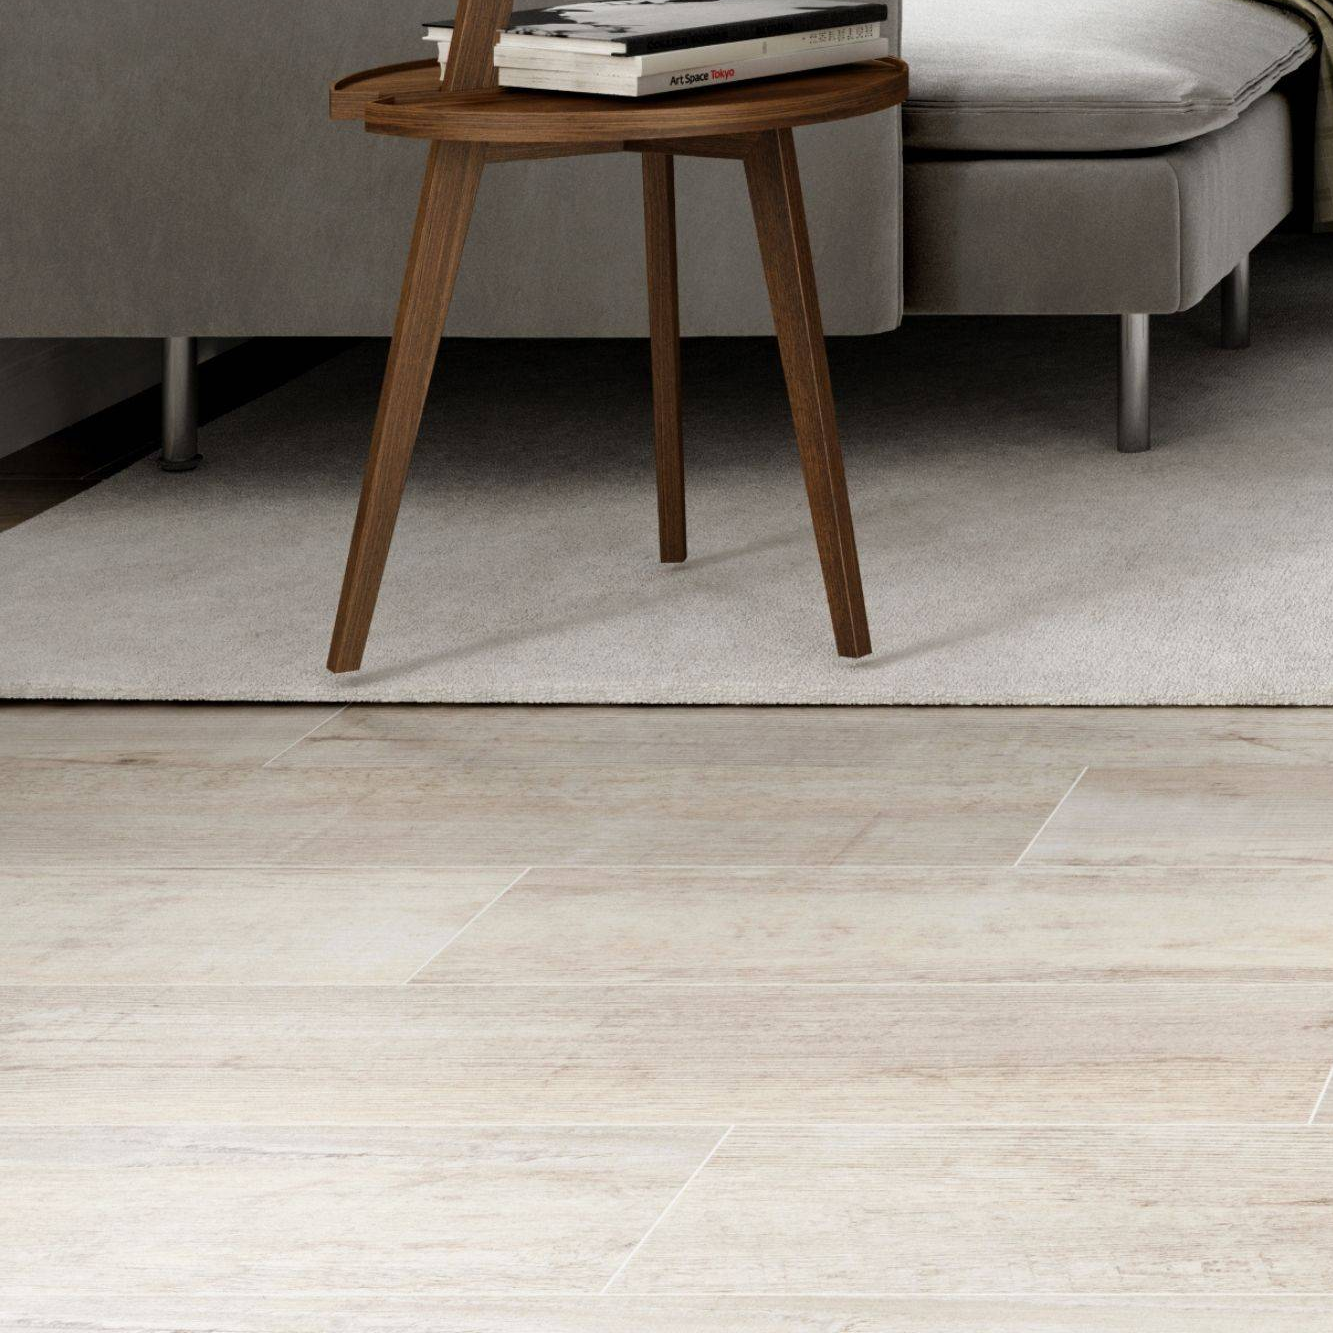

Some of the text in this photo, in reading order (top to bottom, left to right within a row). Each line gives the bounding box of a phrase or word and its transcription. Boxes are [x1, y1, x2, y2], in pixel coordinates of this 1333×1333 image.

[670, 68, 735, 86] Art Space Tokyo
